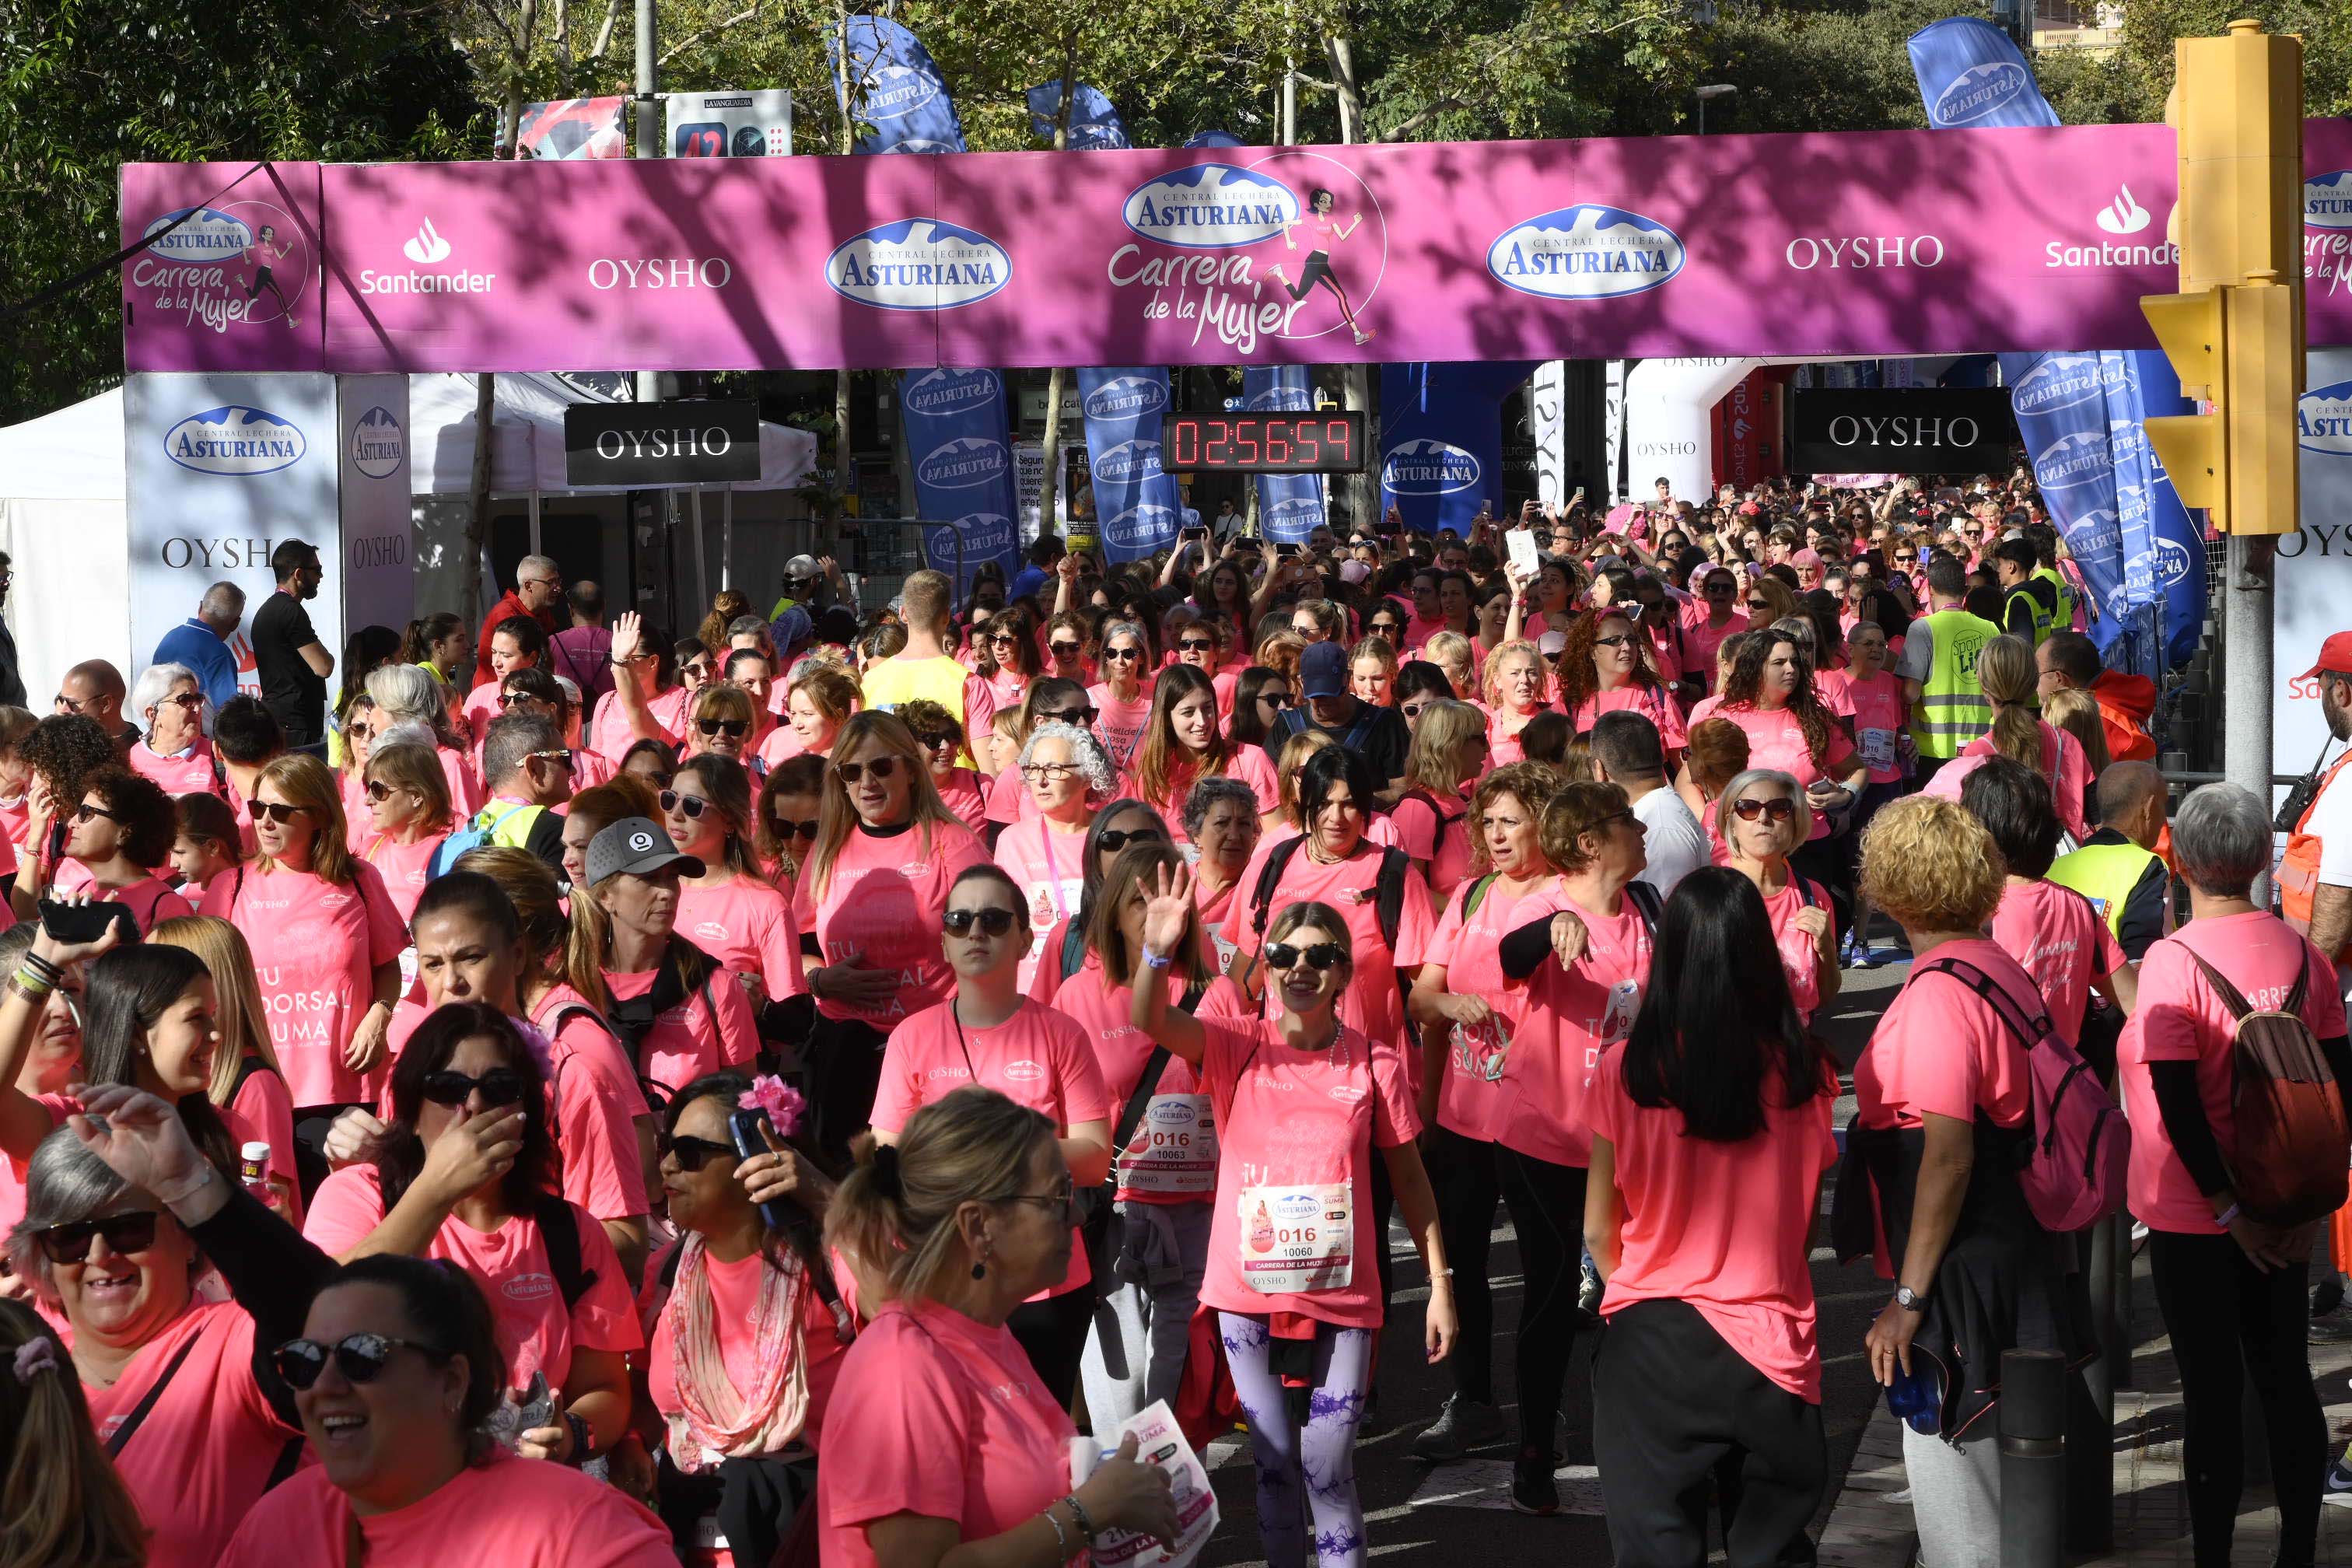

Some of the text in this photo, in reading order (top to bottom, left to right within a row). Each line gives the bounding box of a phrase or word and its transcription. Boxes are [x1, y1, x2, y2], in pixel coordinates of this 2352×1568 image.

[714, 99, 752, 107] VANGUARDIA
[1164, 193, 1219, 201] CENTRAL
[1136, 196, 1286, 226] ASTURIANA
[151, 228, 243, 248] ASTURIANA
[1533, 236, 1664, 247] CENTRAL LECHERA
[1503, 241, 1670, 275] ASTURIANA
[1787, 236, 1944, 270] OYSHO
[2046, 241, 2179, 268] Santande
[132, 259, 223, 287] Carrera
[588, 258, 731, 289] OYSHO
[840, 254, 997, 286] ASTURIANA
[1108, 243, 1253, 287] Carrera
[2318, 257, 2332, 278] la
[360, 269, 495, 294] Santander
[156, 285, 259, 333] de la Mujer
[1144, 282, 1307, 354] de la Mujer
[1829, 415, 1979, 446] OYSHO
[175, 432, 296, 458] ASTURIANA
[355, 435, 401, 461] ASTURIANA
[597, 427, 731, 460] OYSHO
[1176, 421, 1349, 464] 02:56:59
[1637, 441, 1696, 456] OYSHO
[1020, 469, 1032, 478] que
[1384, 462, 1472, 483] ASTURIANA
[1020, 498, 1036, 507] este
[162, 537, 305, 569] OYSH
[354, 535, 404, 569] OYSHO
[1953, 634, 1983, 656] Sport
[828, 940, 854, 961] TU
[2247, 985, 2289, 1009] ARRE
[273, 1020, 329, 1043] UMA
[1153, 1111, 1191, 1119] ASTURIANA
[1153, 1132, 1190, 1146] 016
[1157, 1150, 1185, 1159] 10063
[1128, 1174, 1158, 1183] OYSHO
[1276, 1205, 1317, 1213] ASTURIANA
[1279, 1227, 1316, 1243] 016
[1283, 1247, 1313, 1257] 10060
[1253, 1276, 1286, 1286] OYSHO
[1136, 1539, 1150, 1550] LA
